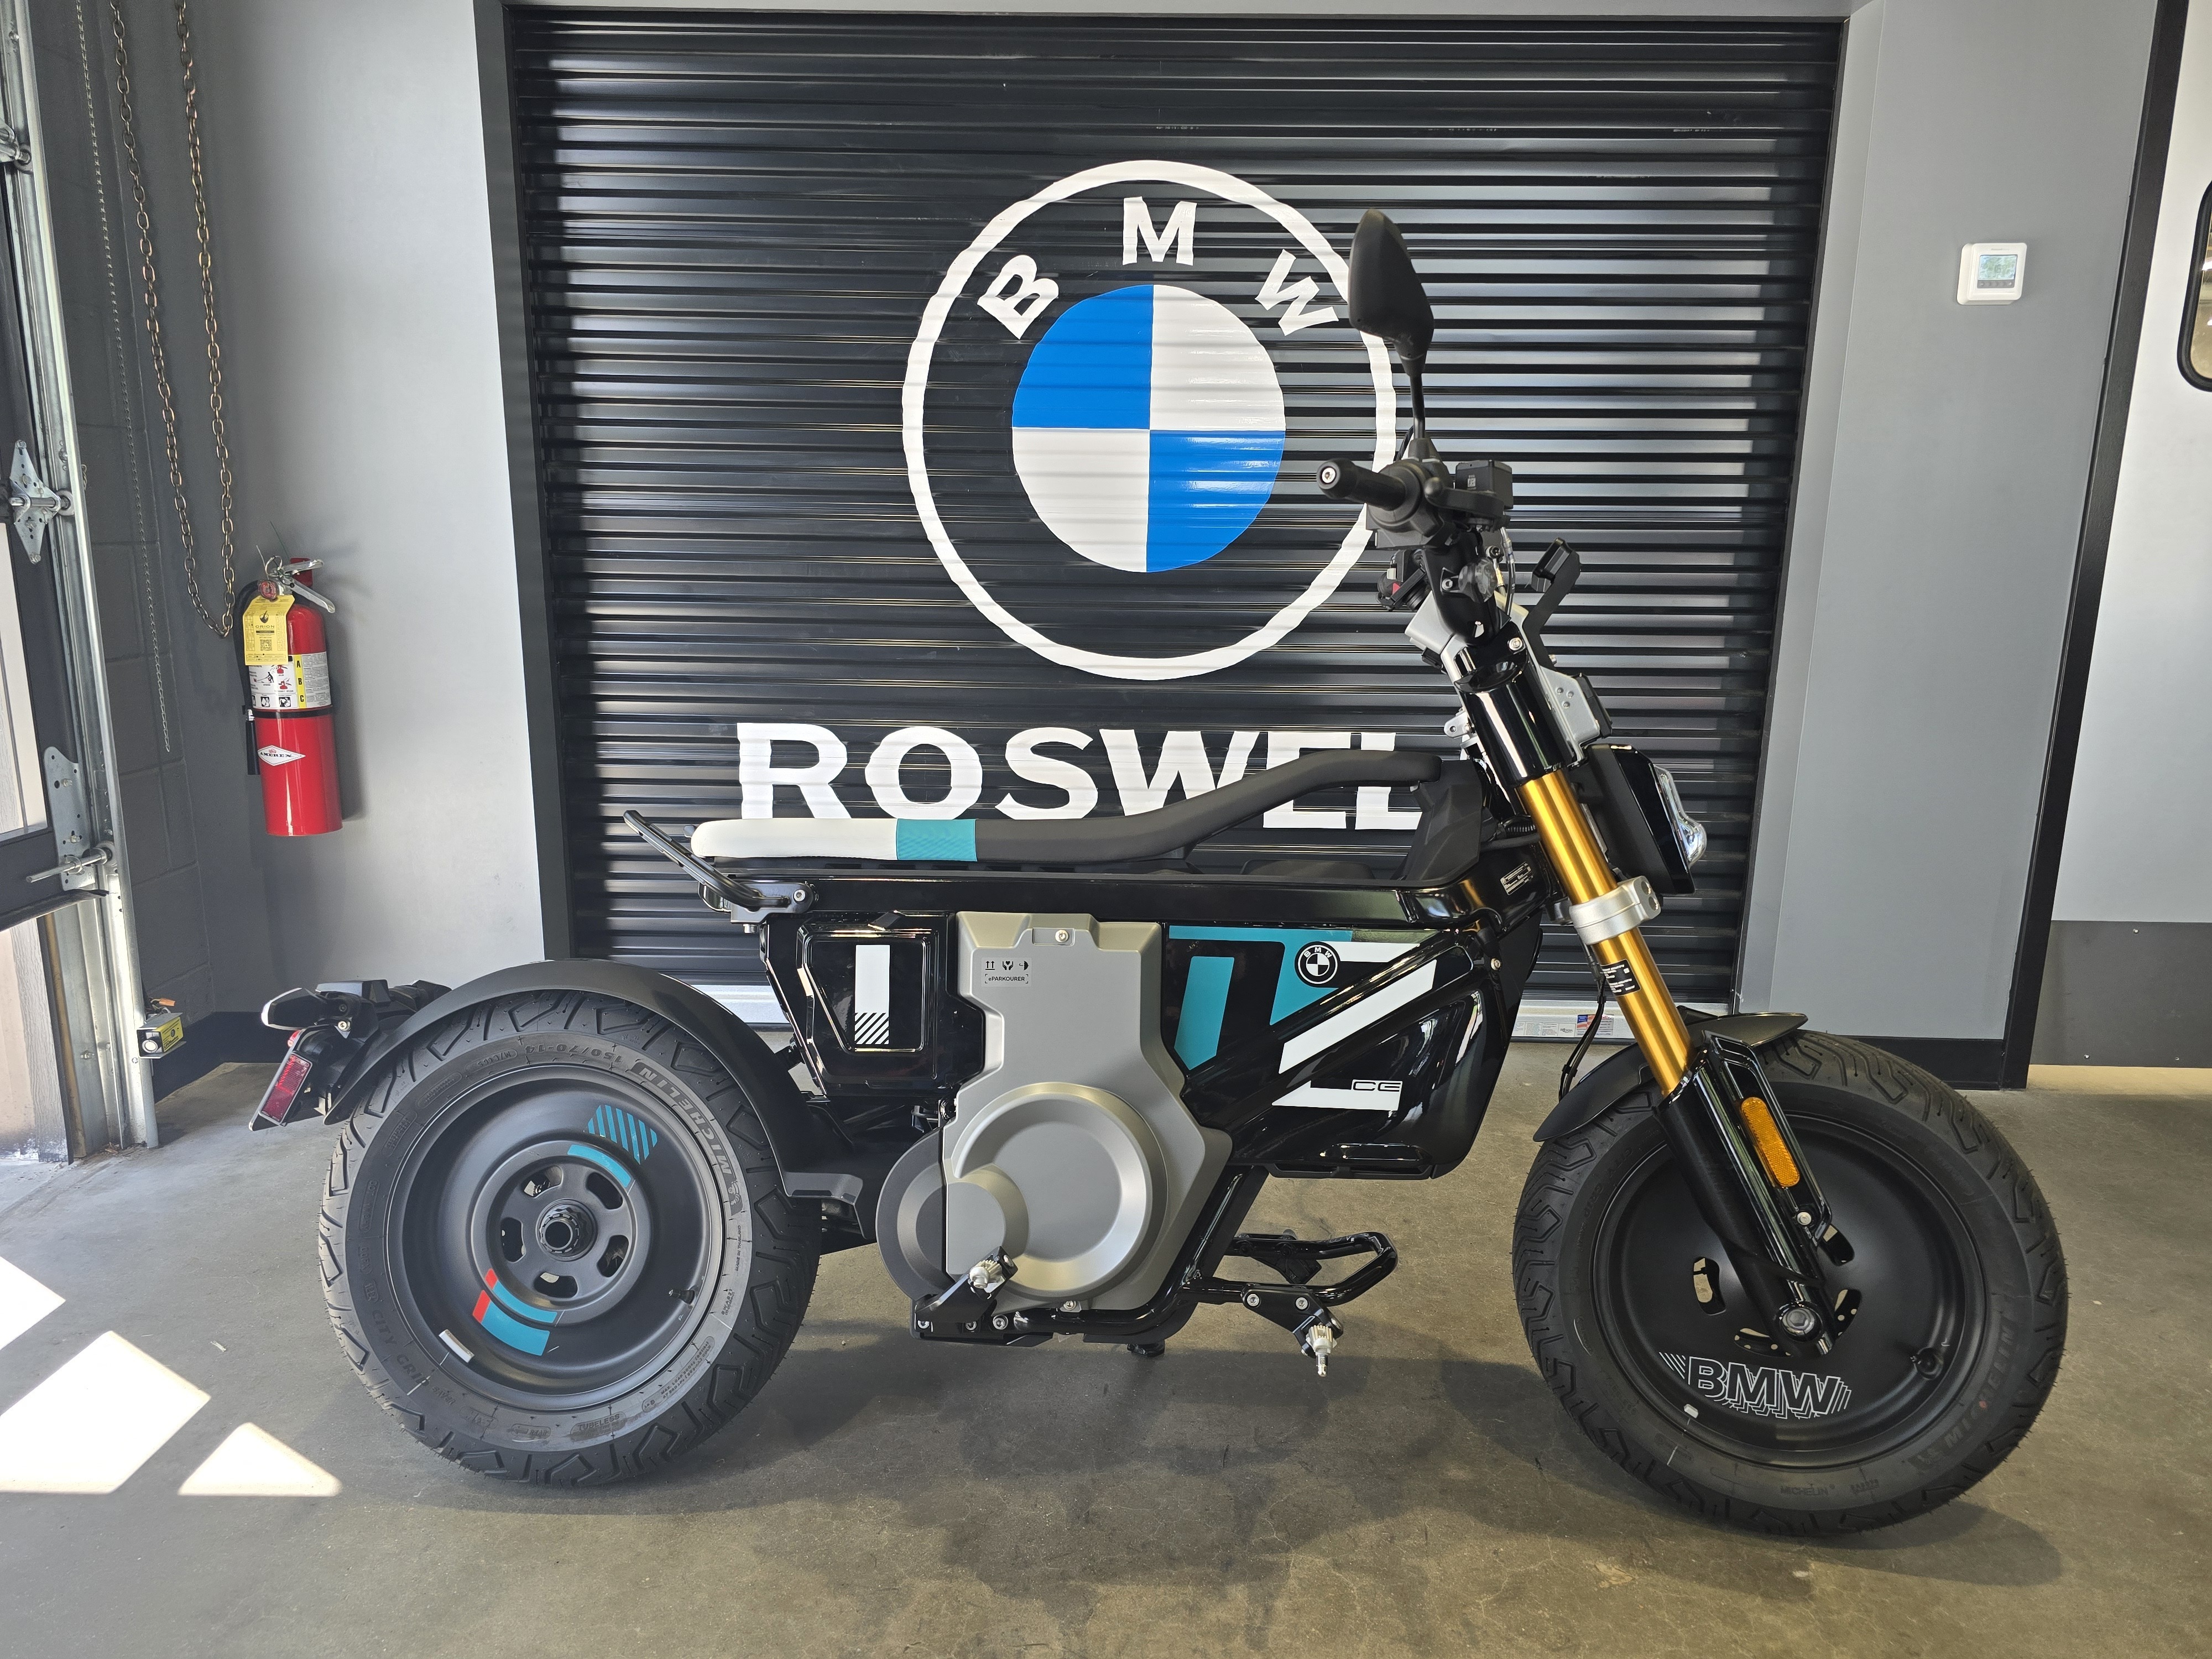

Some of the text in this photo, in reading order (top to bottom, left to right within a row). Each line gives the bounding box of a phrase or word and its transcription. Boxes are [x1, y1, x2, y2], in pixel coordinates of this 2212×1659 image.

[978, 196, 1338, 338] BMW
[737, 723, 1470, 830] ROSWEL
[1304, 946, 1333, 958] BMW
[639, 1067, 733, 1175] MICHELIN
[372, 1310, 398, 1346] CITY
[1688, 1356, 1850, 1419] BMW
[577, 1413, 620, 1431] TUBELESS
